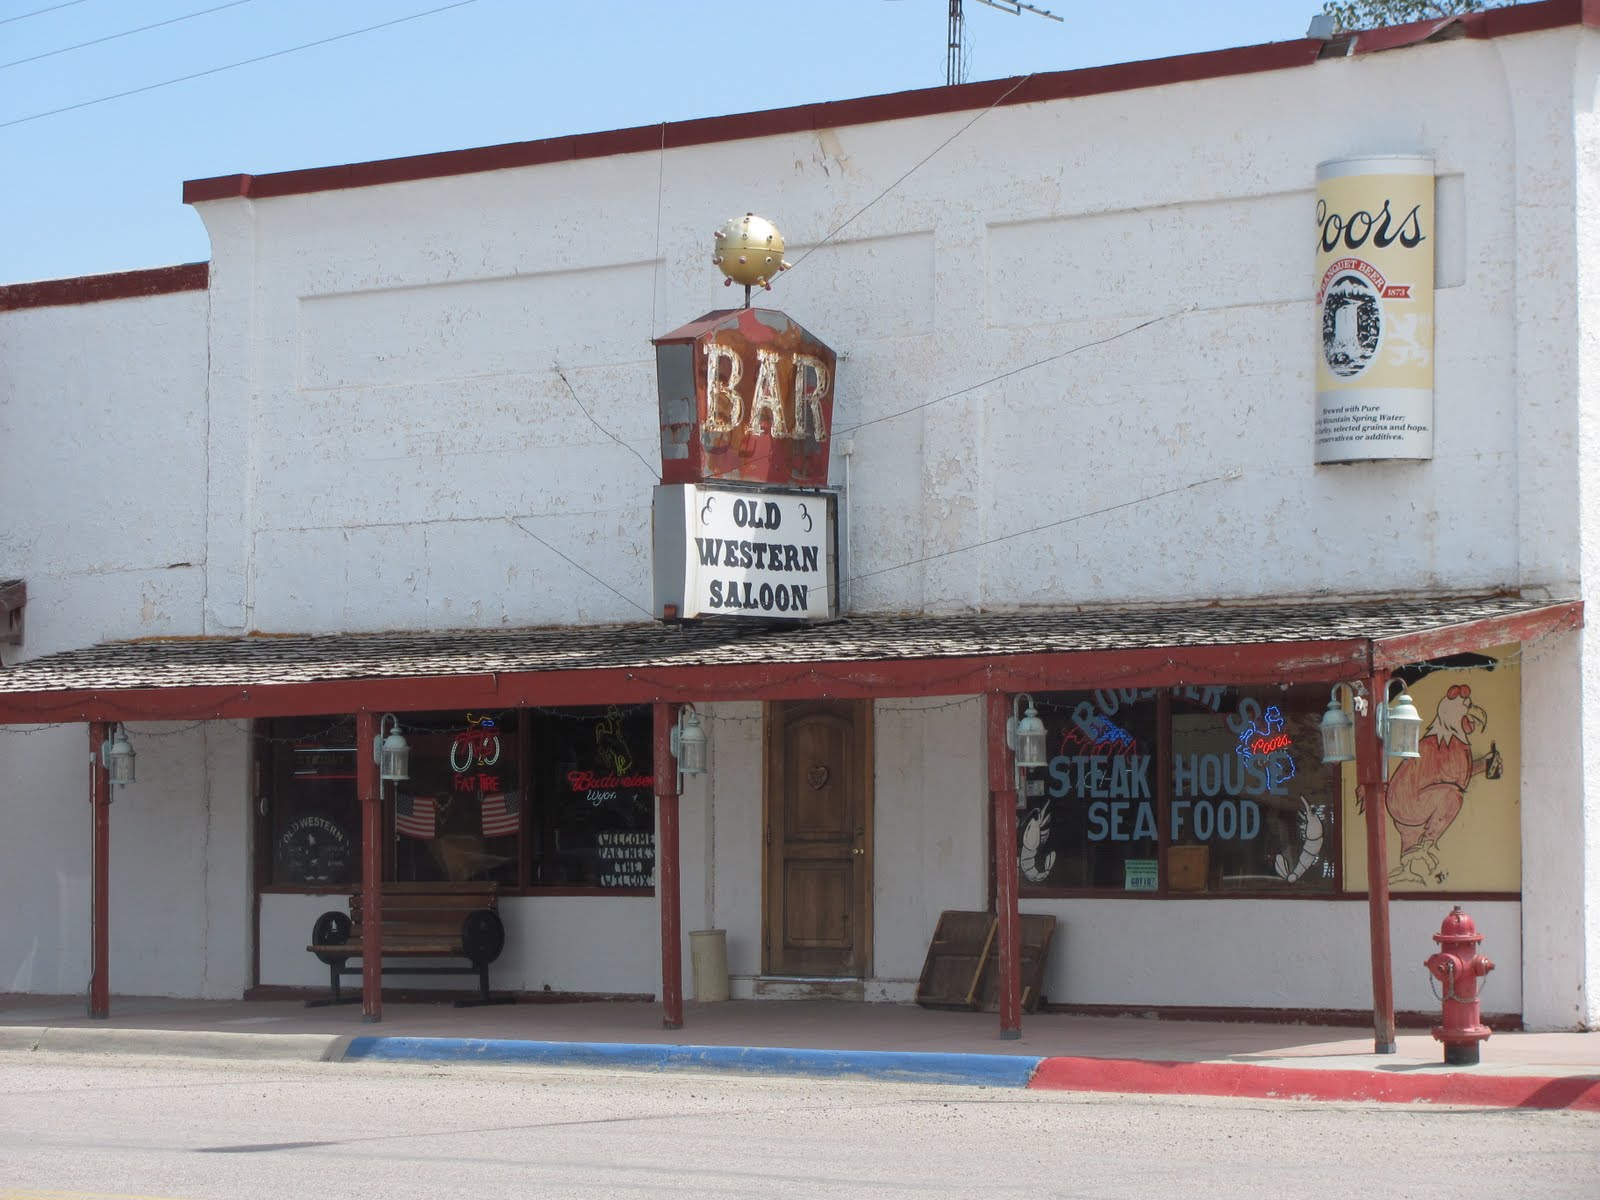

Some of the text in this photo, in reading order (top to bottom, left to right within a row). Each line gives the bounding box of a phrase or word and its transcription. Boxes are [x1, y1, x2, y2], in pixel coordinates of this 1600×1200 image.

[1358, 262, 1385, 289] BEER
[1387, 288, 1406, 297] 1873
[703, 343, 831, 442] BAR
[1345, 405, 1360, 413] with
[1352, 414, 1378, 423] Spring
[1333, 424, 1361, 433] selected
[1361, 424, 1388, 433] grains
[1406, 424, 1430, 432] hops.
[1365, 433, 1404, 441] additives.
[733, 499, 781, 530] OLD
[695, 537, 819, 572] WESTERN
[709, 580, 808, 611] SALOON
[1251, 734, 1293, 755] Coors
[453, 773, 502, 792] FAT TIRE
[1049, 755, 1151, 799] STEAK
[1175, 752, 1288, 797] HOUSE
[283, 816, 344, 844] OLD WESTERN
[1088, 800, 1259, 841] SEA FOOD
[599, 833, 655, 846] WELCOME
[615, 862, 641, 873] THE
